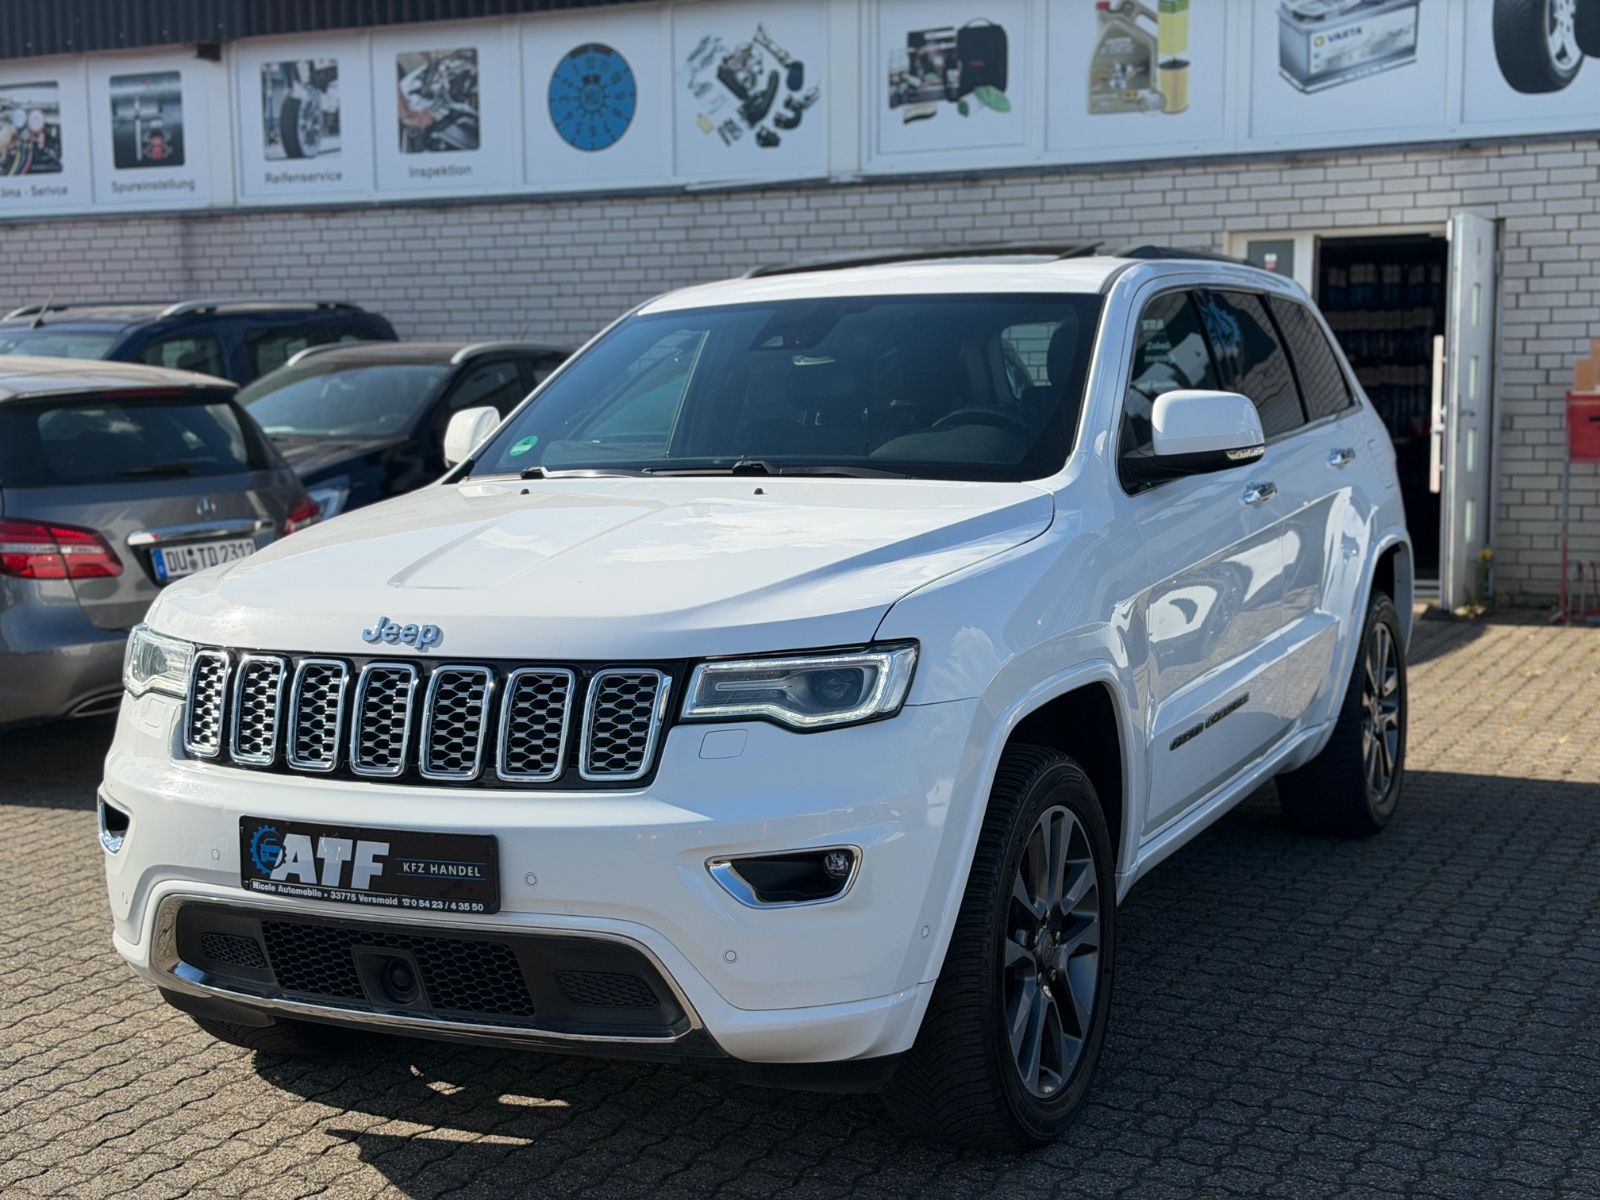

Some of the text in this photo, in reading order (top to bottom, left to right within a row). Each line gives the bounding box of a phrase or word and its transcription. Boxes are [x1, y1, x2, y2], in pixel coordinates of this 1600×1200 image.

[1326, 26, 1363, 43] VARTA
[264, 169, 343, 186] Reifenservice
[407, 163, 473, 180] Inspektion
[111, 177, 196, 195] Spureinstellung
[166, 549, 188, 572] DU
[197, 546, 218, 568] TD
[362, 616, 441, 651] Jeep
[270, 833, 390, 890] ATF
[403, 862, 481, 877] KFZ HANDEL
[252, 880, 276, 892] Nicole
[278, 885, 322, 898] Automobile
[330, 890, 357, 902] 33775
[358, 894, 398, 906] Versmold
